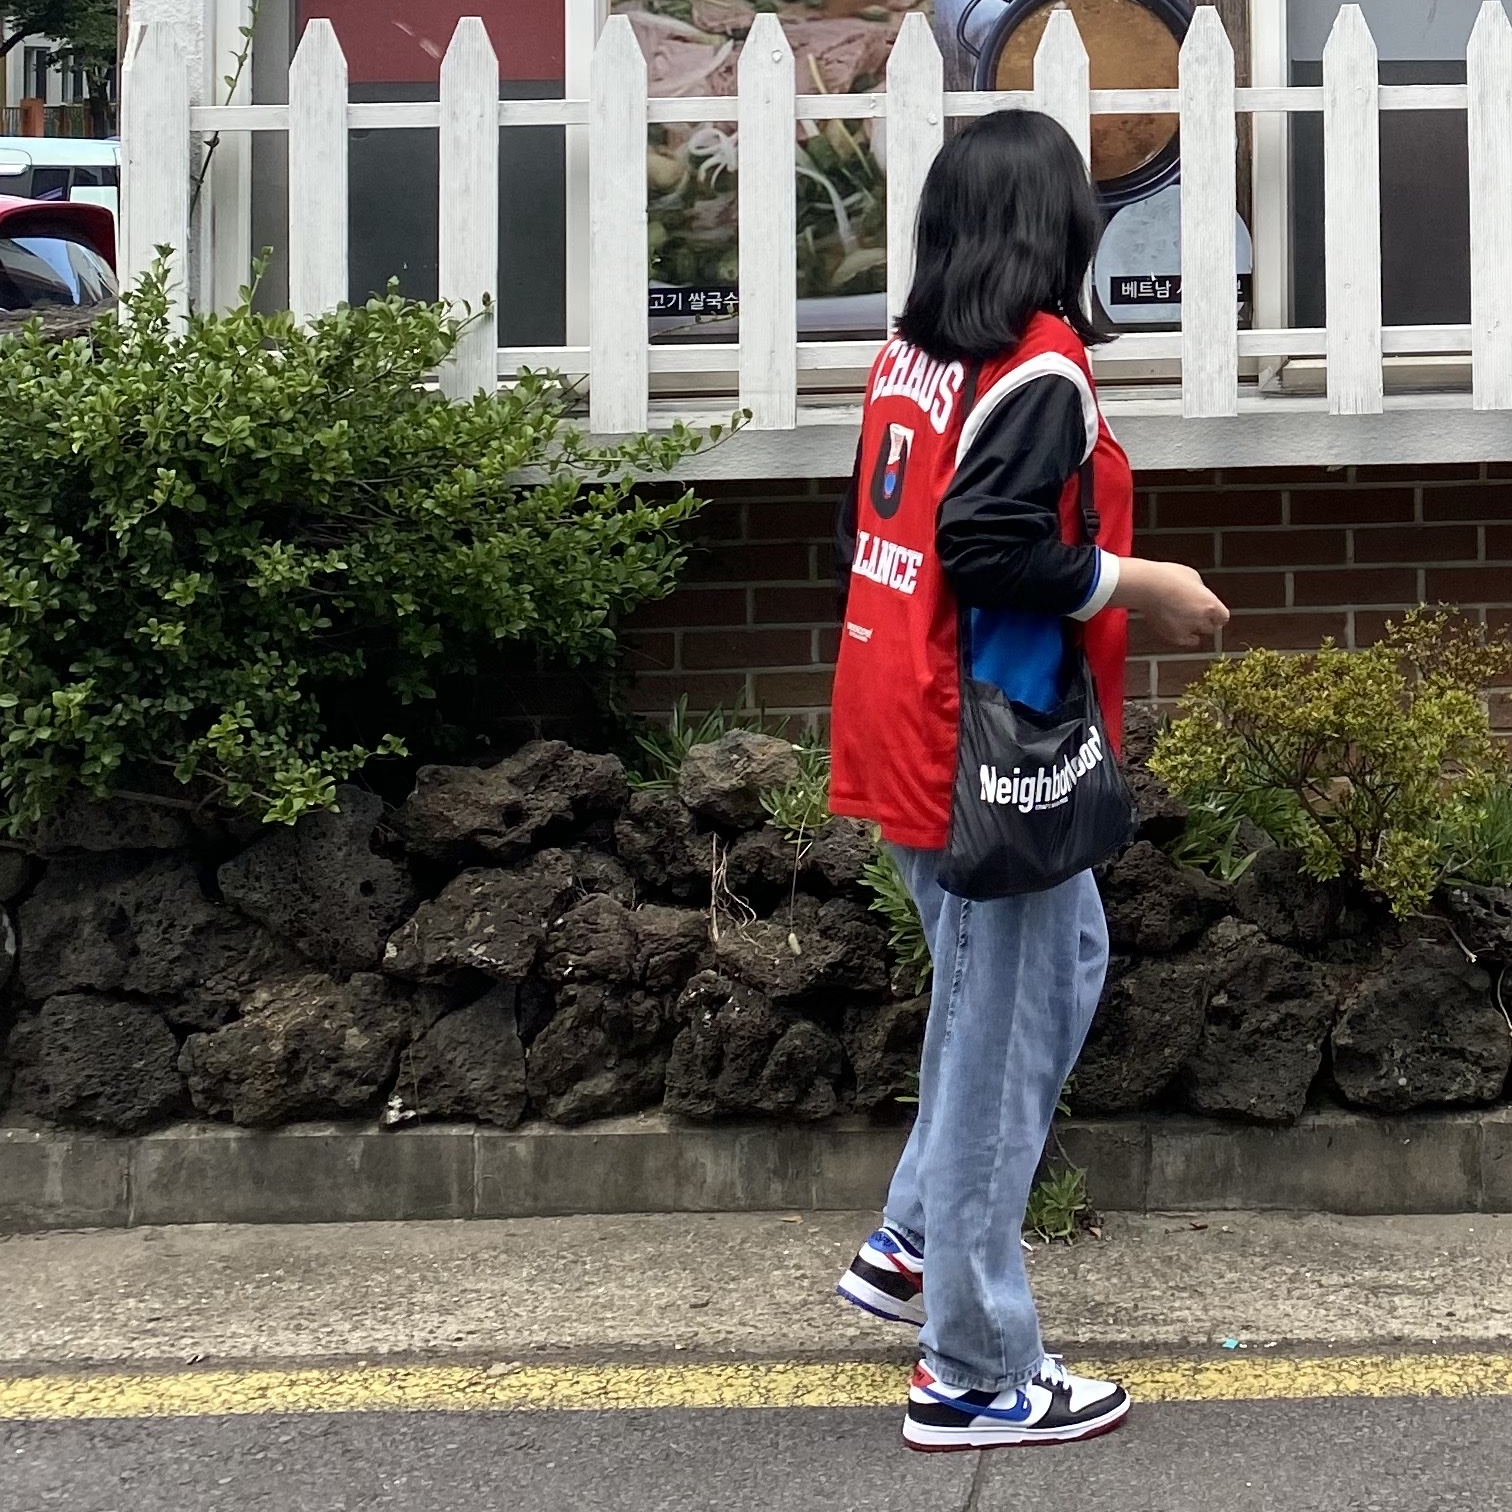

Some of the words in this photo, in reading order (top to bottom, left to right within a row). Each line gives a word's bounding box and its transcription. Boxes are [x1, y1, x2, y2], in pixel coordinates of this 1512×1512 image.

[1121, 280, 1172, 299] 베트남
[648, 293, 682, 311] 고기
[688, 291, 740, 312] 쌀국수
[851, 529, 924, 595] LANCE
